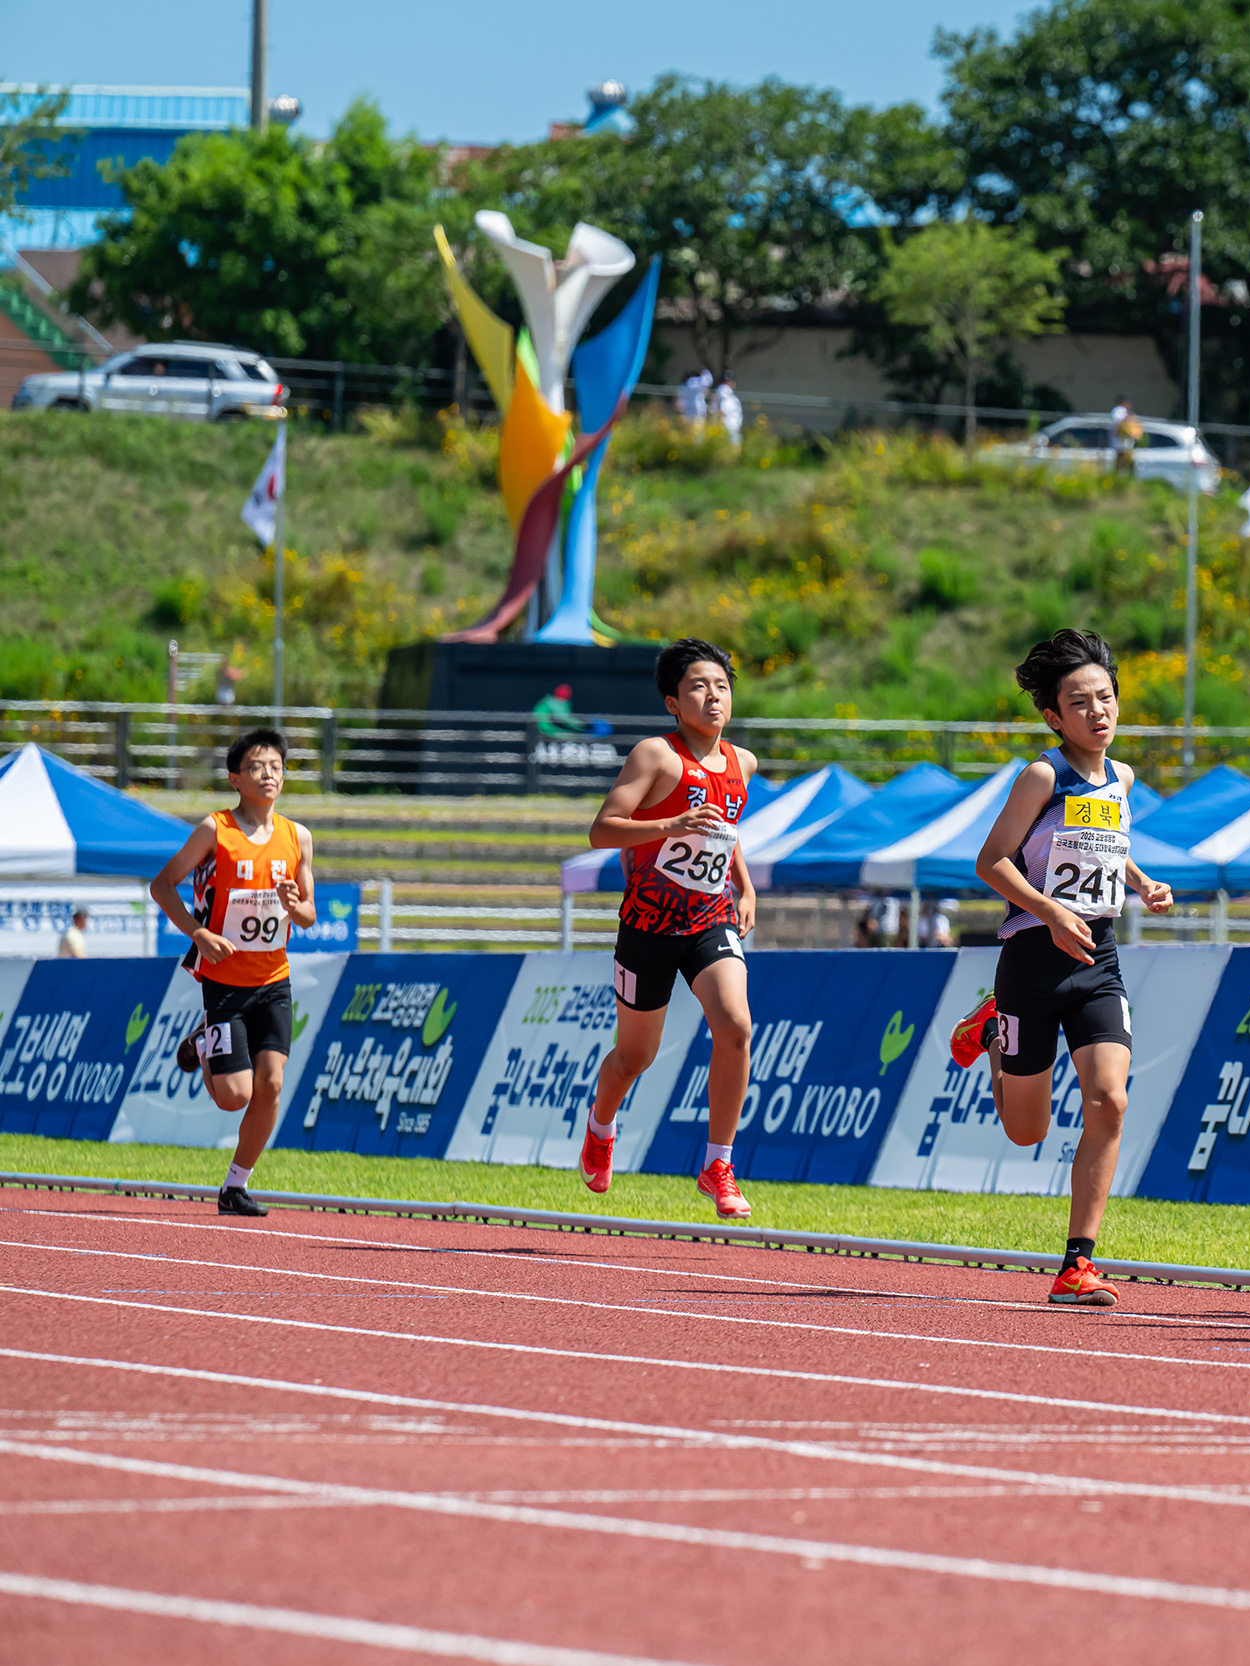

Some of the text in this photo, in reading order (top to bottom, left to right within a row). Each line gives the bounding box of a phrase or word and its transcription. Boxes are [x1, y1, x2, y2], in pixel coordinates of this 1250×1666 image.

[1075, 801, 1113, 827] 경북
[662, 842, 727, 884] 258
[1051, 862, 1119, 906] 241
[239, 916, 280, 943] 99
[0, 1010, 125, 1104] 교보생명 KYOBO
[210, 1026, 223, 1055] 2
[303, 1034, 454, 1131] 꿈나무체육대회
[480, 1042, 642, 1139] 꿈나무체육
[792, 1084, 881, 1139] KYOBO
